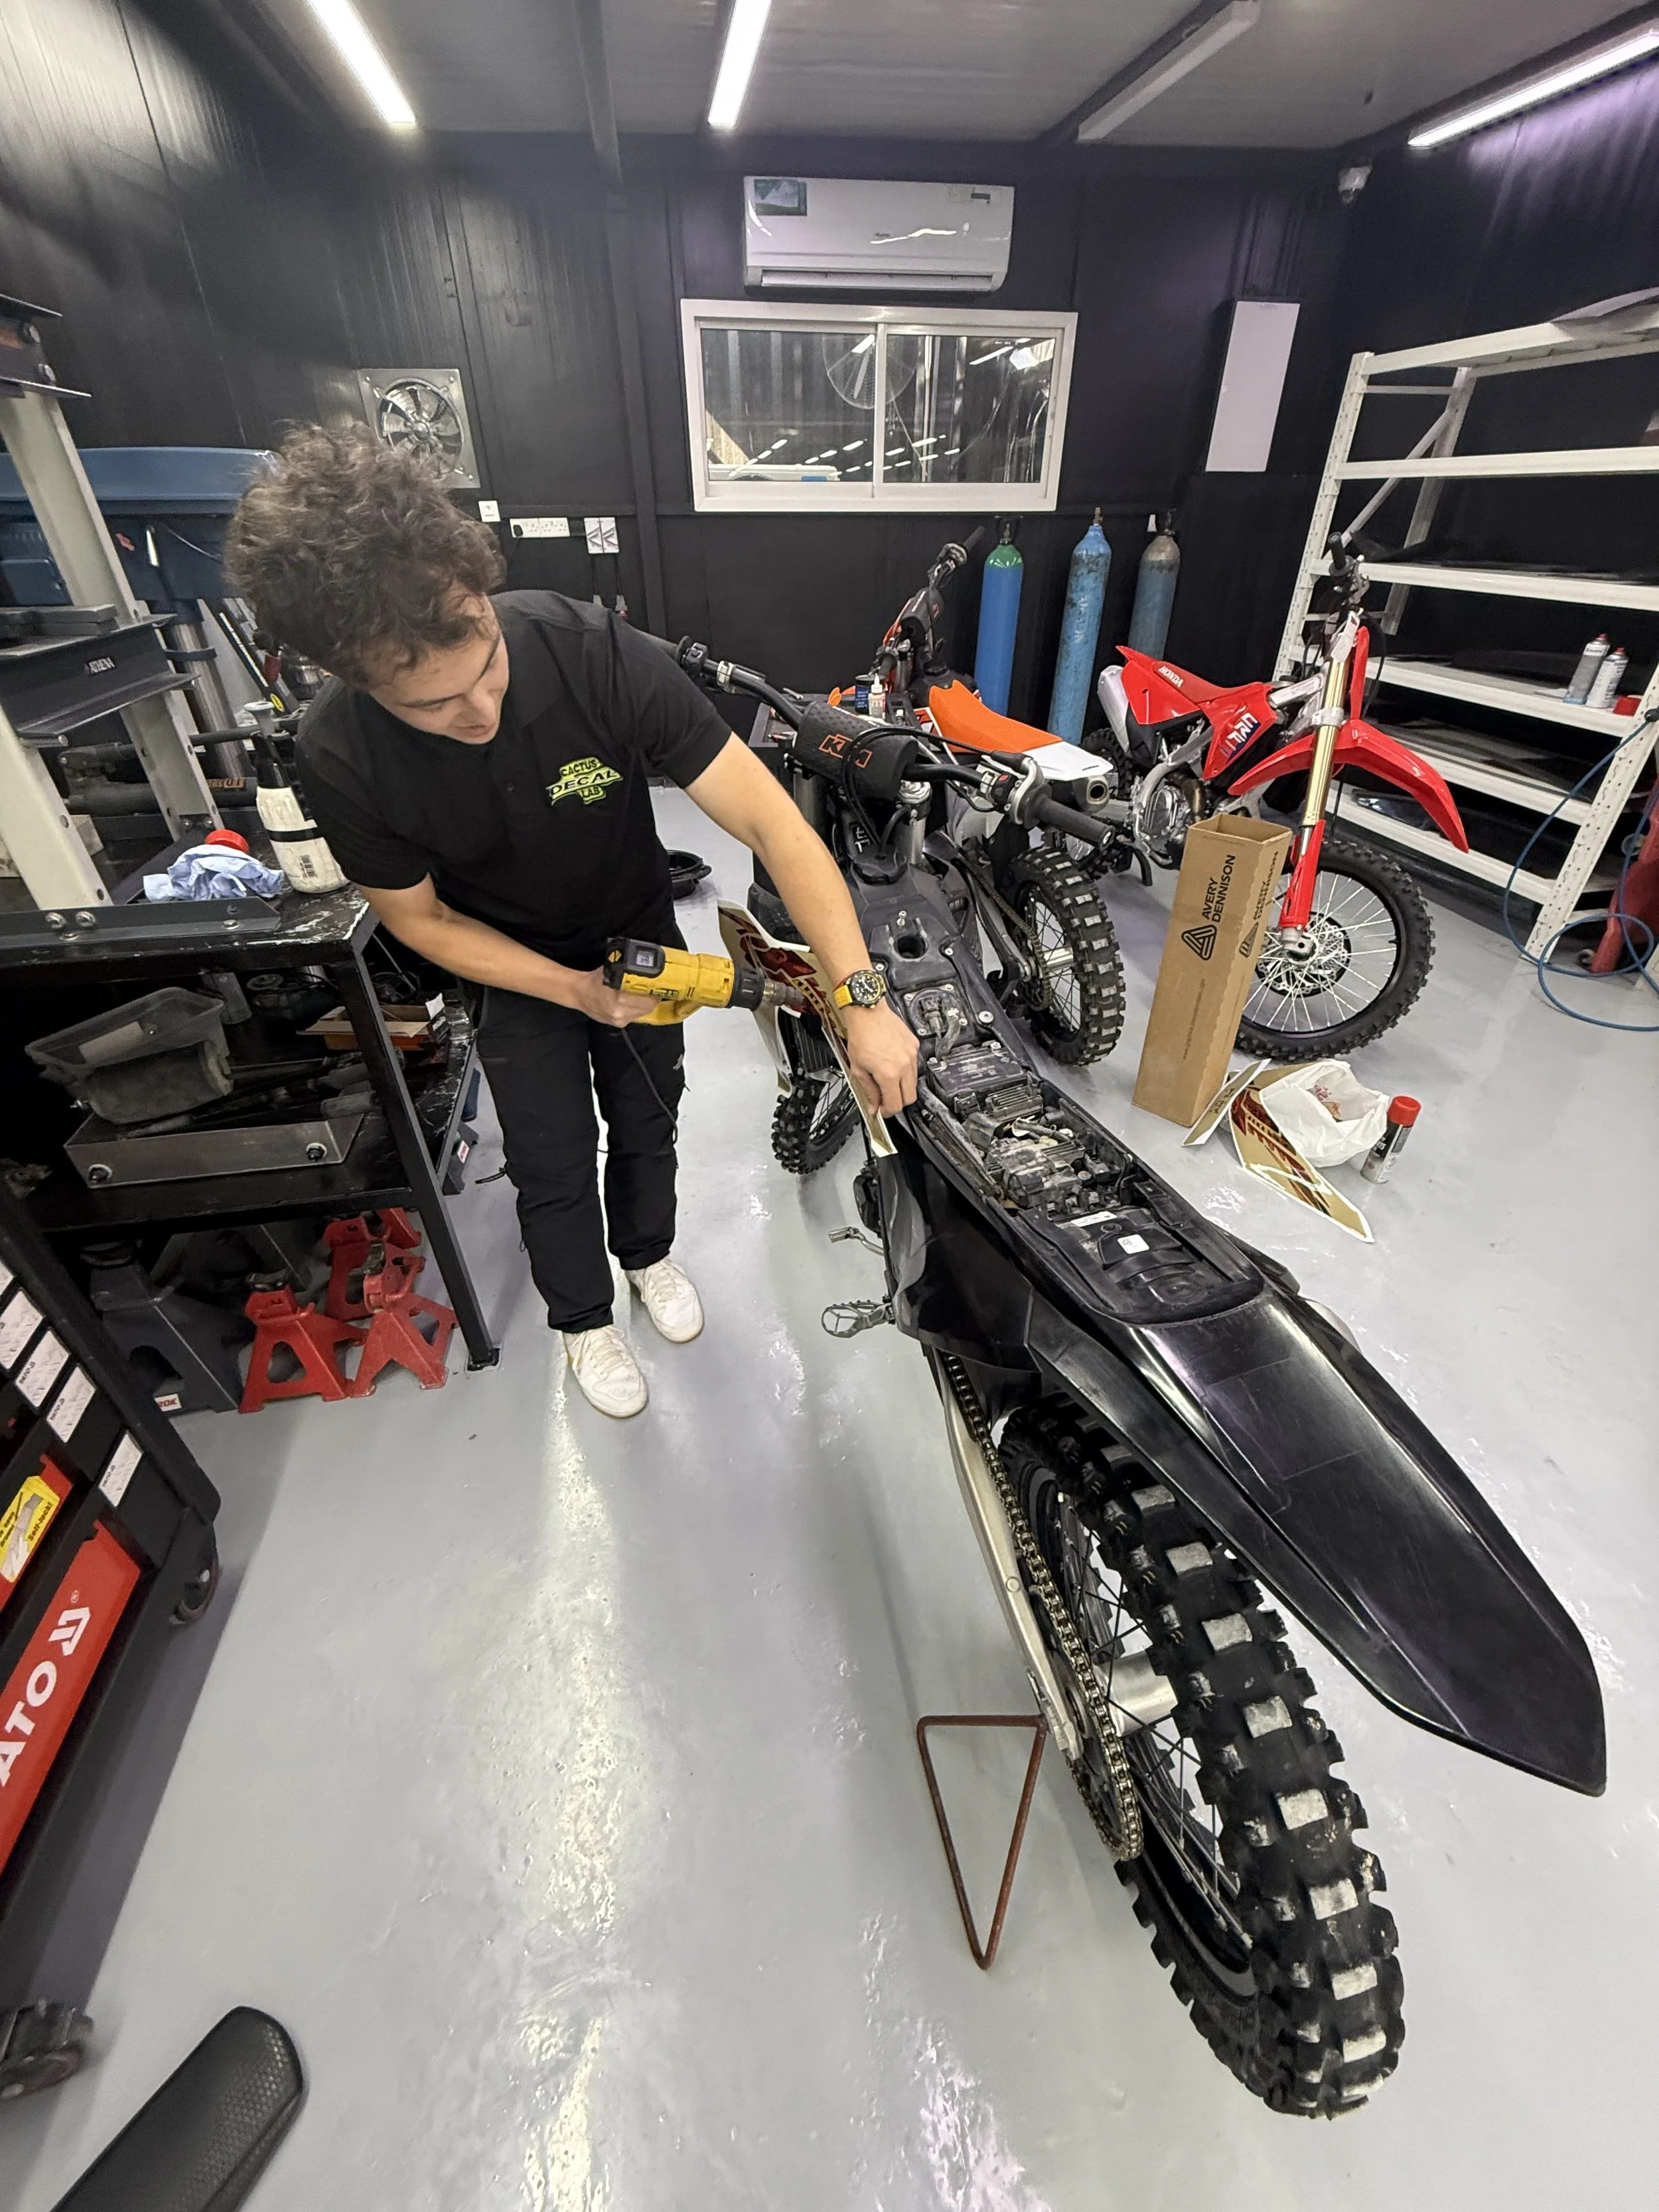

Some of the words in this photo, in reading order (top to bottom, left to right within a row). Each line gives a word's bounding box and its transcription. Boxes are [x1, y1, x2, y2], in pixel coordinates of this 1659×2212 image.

[1157, 666, 1185, 688] HONDA
[1226, 712, 1259, 744] CRF
[560, 759, 598, 777] CACTUS
[551, 770, 617, 796] DECAL
[581, 786, 601, 798] LAB
[1201, 877, 1219, 921] AVERY
[1211, 854, 1236, 923] DENNISON
[27, 1501, 54, 1542] Self-lock!
